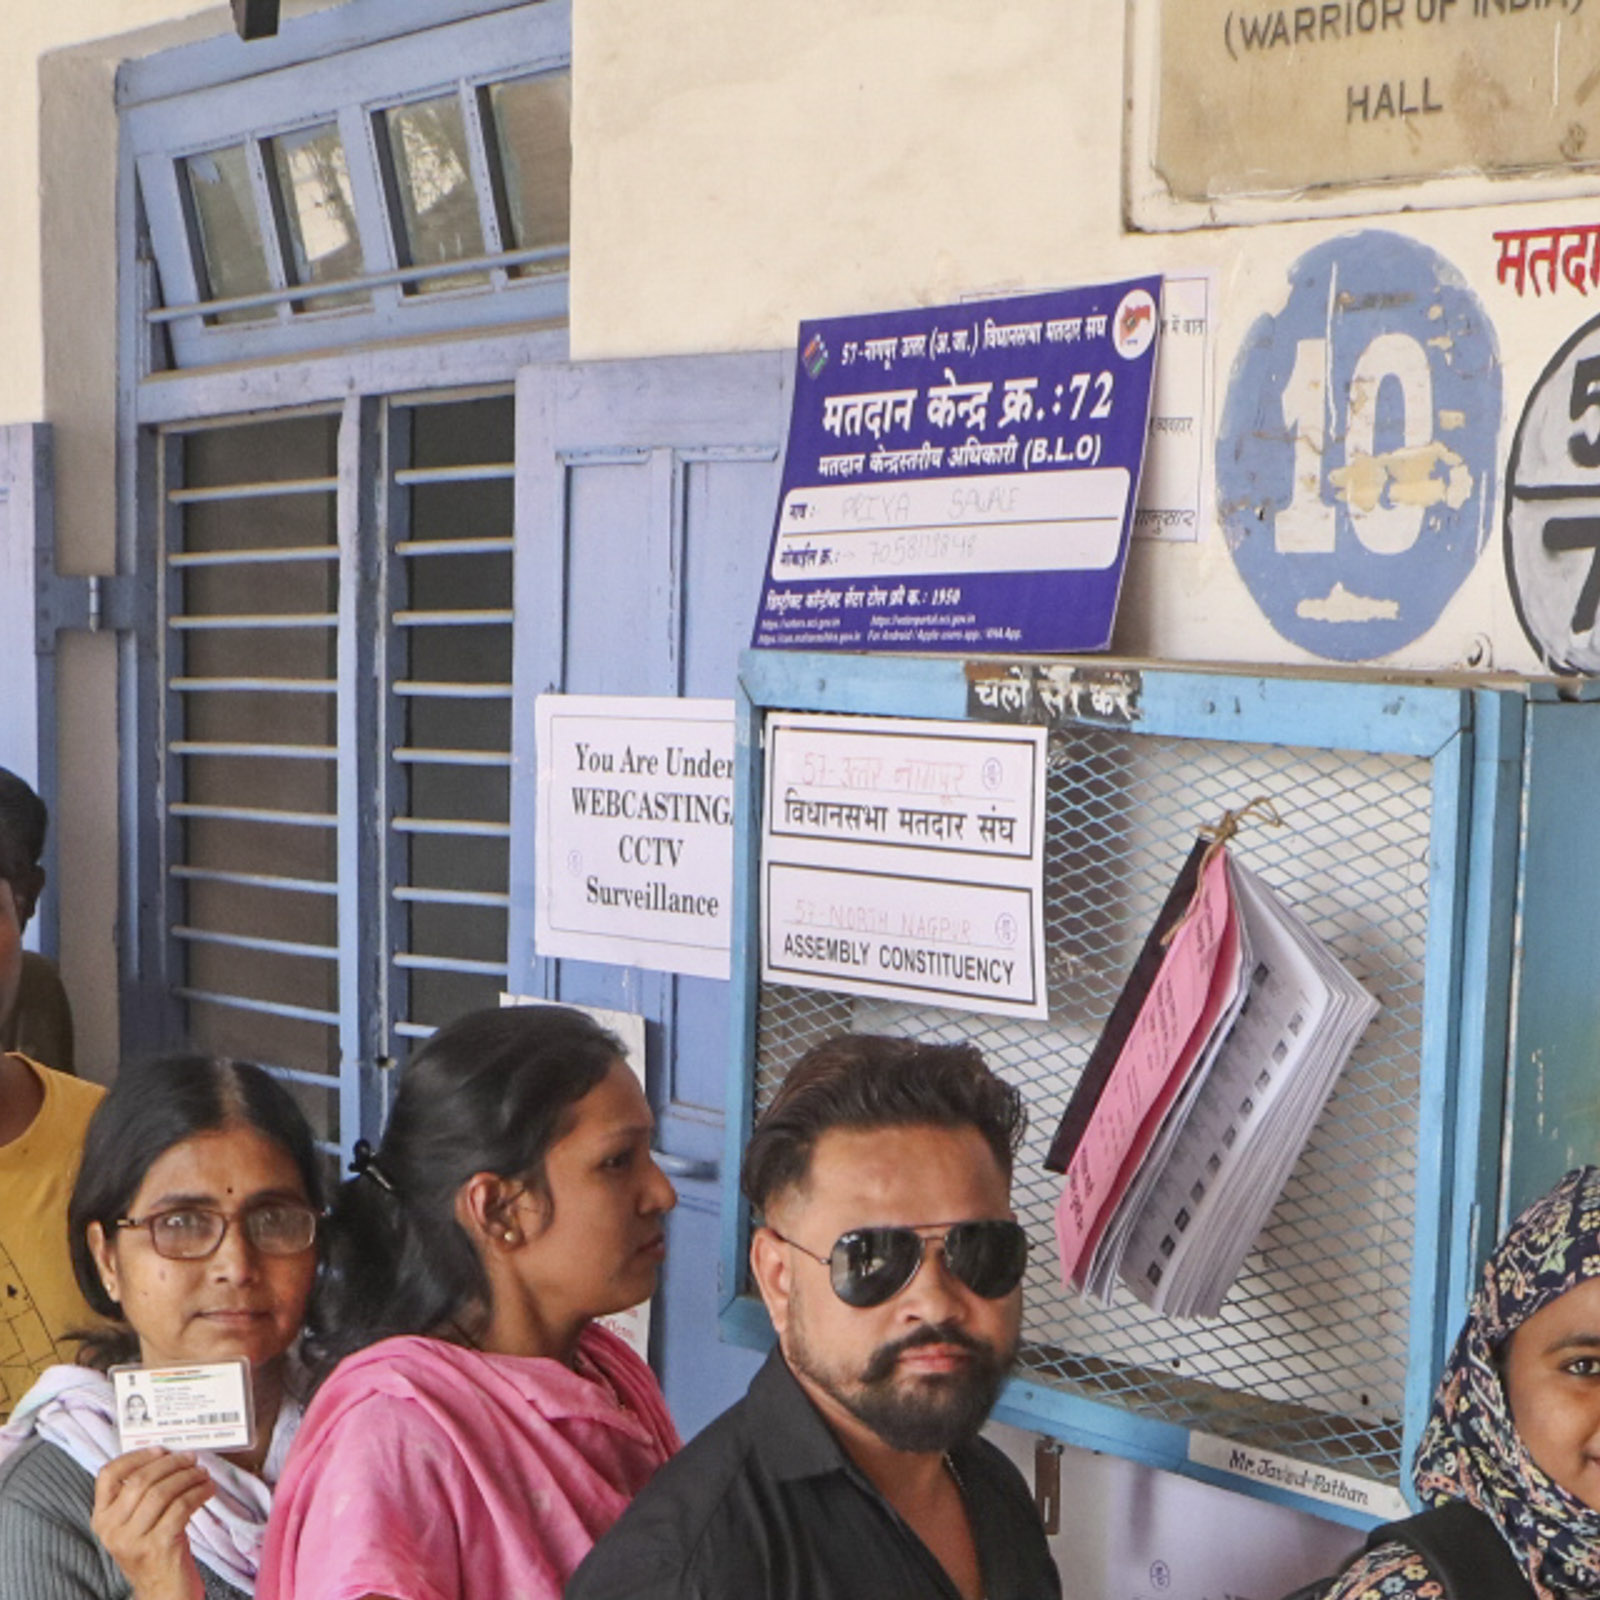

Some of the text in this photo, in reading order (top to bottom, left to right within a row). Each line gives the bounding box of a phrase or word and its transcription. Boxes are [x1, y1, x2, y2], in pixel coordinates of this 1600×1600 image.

[1346, 77, 1444, 125] HALL
[823, 389, 918, 439] मतदान
[927, 367, 993, 431] केन्द्र
[818, 454, 866, 477] मतदान
[948, 434, 1018, 468] अधिकारी
[1023, 434, 1101, 471] (B.L.O)
[575, 742, 734, 779] You Are Under
[571, 787, 734, 826] WEBCASTING
[784, 787, 1017, 843] विधानसभा मतदार संघ
[618, 834, 684, 868] CCTV
[586, 875, 719, 918] Surveillance
[784, 933, 1015, 986] ASSEMBLY CONSTITUENCY
